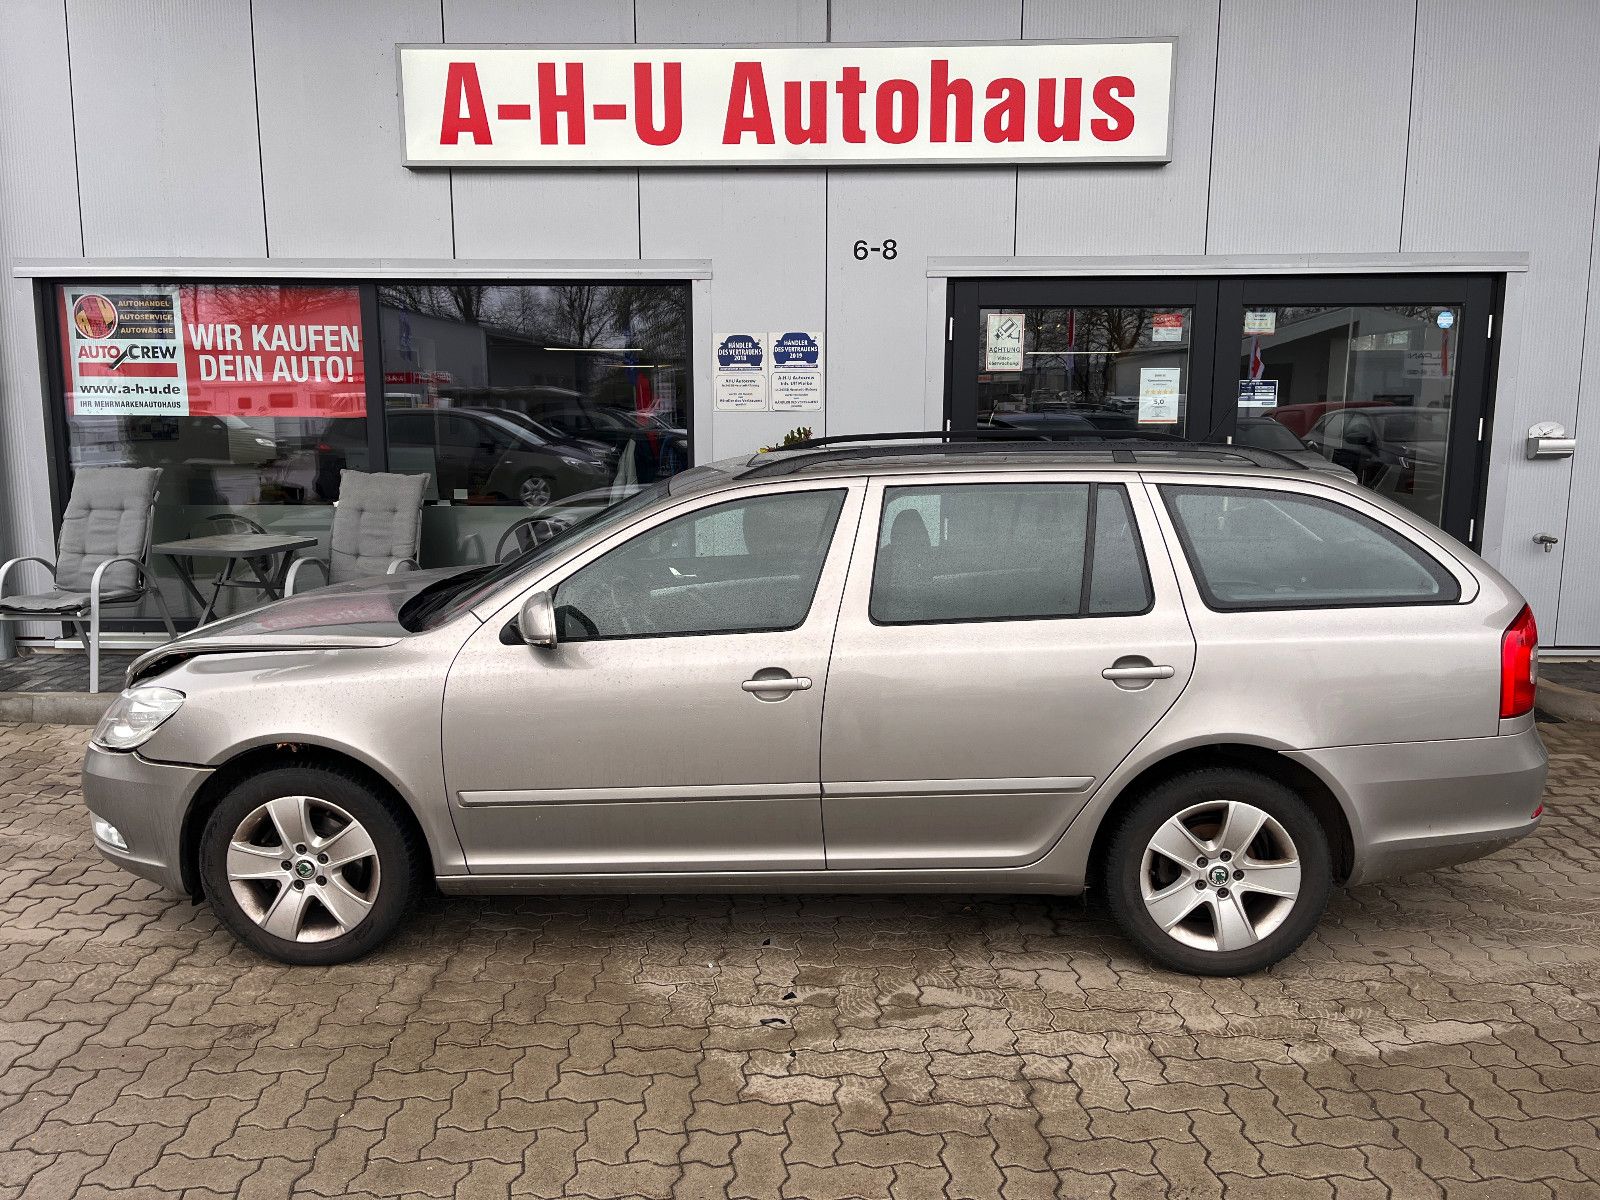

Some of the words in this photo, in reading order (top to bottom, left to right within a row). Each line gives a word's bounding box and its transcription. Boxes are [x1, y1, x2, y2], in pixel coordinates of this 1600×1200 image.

[439, 62, 683, 146] A-H-U
[722, 59, 1136, 145] Autohaus
[853, 239, 898, 260] 6-8
[118, 300, 170, 308] AUTOHANDEL
[119, 313, 173, 321] AUTOSERVICE
[188, 323, 244, 351] WIR
[251, 324, 360, 352] KAUFEN
[198, 354, 264, 382] DEIN
[272, 355, 355, 383] AUTO!
[80, 384, 181, 395] www.a-h-u.de
[80, 400, 93, 408] IHR
[94, 400, 181, 409] MEHRMARKENAUTOHAUS
